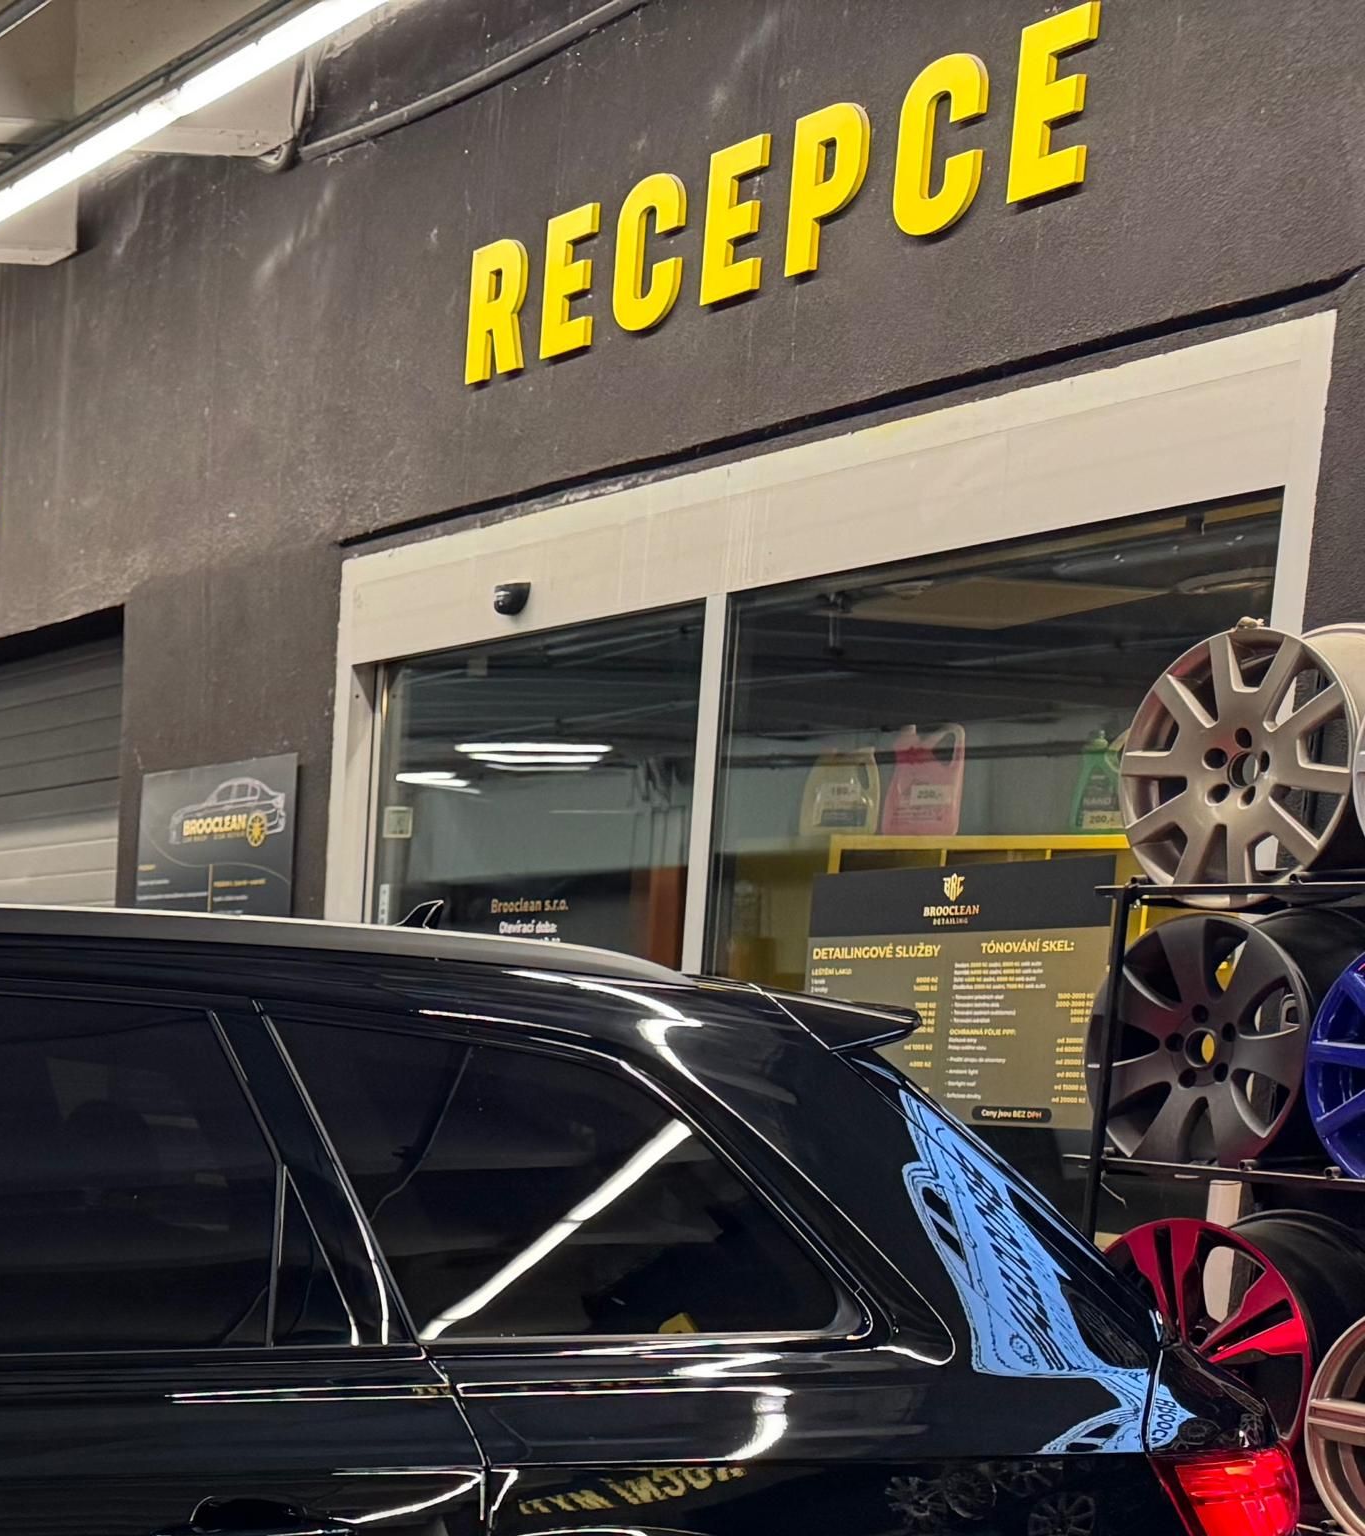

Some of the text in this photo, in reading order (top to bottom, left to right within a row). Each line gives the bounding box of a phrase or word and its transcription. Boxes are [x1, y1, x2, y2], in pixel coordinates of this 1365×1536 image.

[464, 0, 1101, 386] RECEPCE
[182, 814, 248, 837] BROOCLEAN
[490, 897, 569, 914] Brooclean s.r.o.
[922, 904, 981, 917] BROOCLEAN
[812, 942, 942, 960] DETAILINGOVÉ SLUŽBY
[980, 938, 1075, 954] TÓNOVÁNÍ SKEL:
